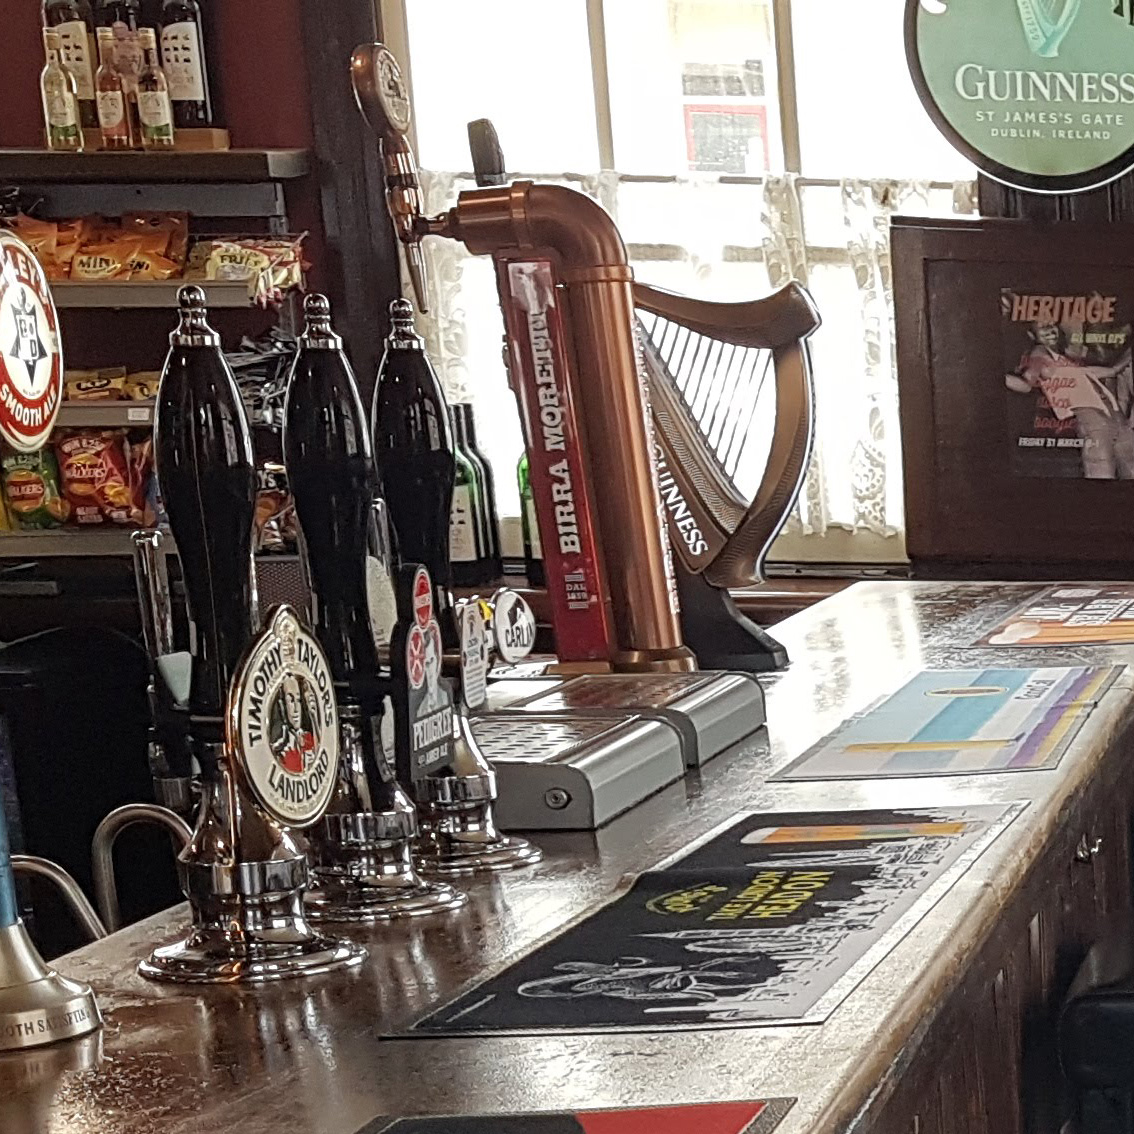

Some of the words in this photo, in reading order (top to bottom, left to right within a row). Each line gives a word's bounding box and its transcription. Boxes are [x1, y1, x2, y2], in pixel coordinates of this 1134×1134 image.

[976, 110, 995, 122] ST
[1003, 111, 1073, 125] JAMES'S
[1081, 113, 1125, 126] GATE
[1052, 130, 1111, 140] IRELAND
[1011, 294, 1117, 324] HERITAGE
[529, 312, 566, 451] MORETTI
[0, 383, 42, 427] SMOOTH
[551, 459, 582, 554] BIRRA
[565, 583, 587, 592] DAL
[505, 624, 535, 648] CARLIN
[248, 641, 282, 748] TIMOTHY
[297, 638, 333, 729] TAYLOR'S
[413, 706, 452, 752] PEDIGRE
[268, 749, 329, 803] LANDLORD
[730, 871, 787, 904] LONDON
